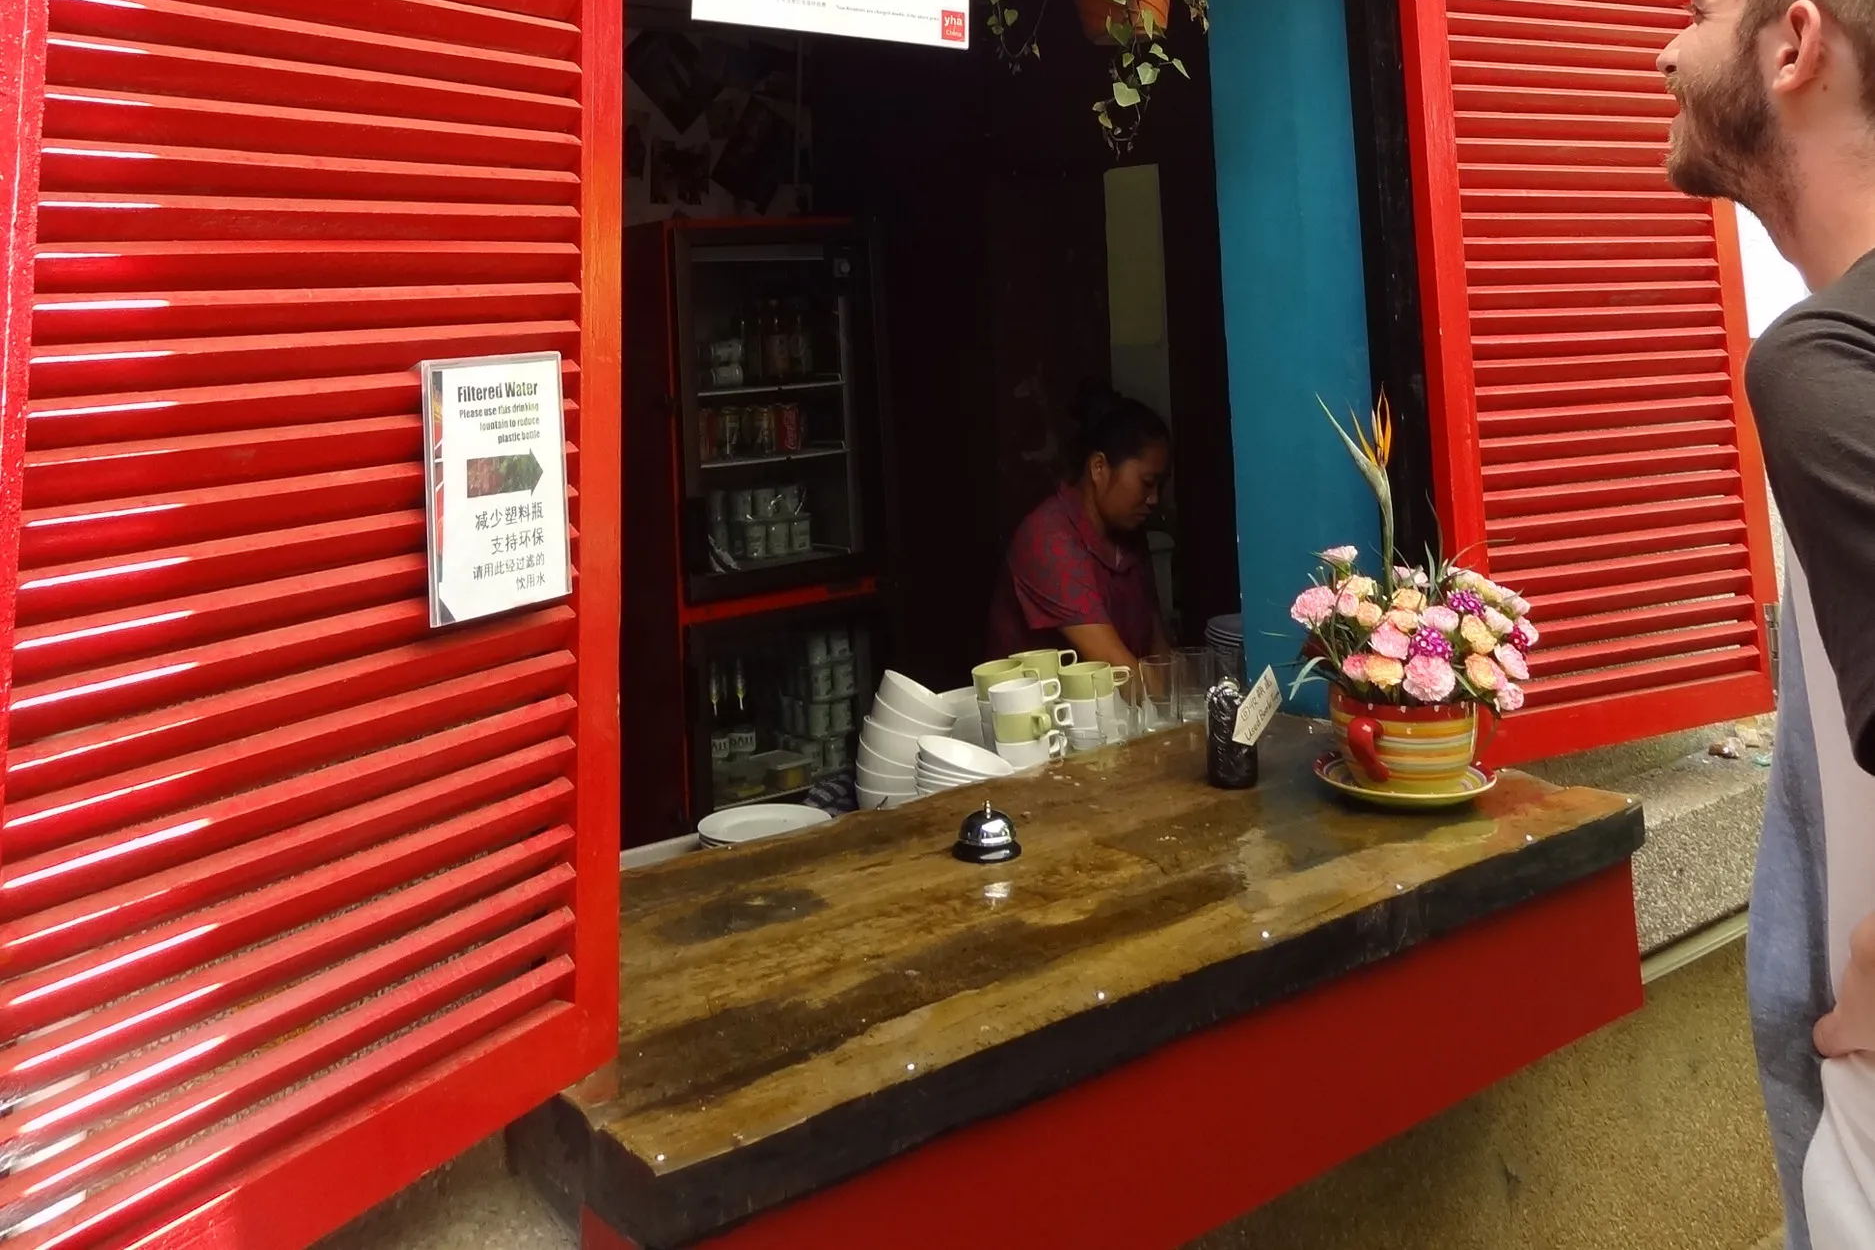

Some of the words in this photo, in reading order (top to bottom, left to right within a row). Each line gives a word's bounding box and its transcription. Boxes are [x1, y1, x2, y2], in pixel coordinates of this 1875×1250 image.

[944, 15, 962, 27] yha
[457, 383, 503, 403] Filtered
[505, 381, 538, 397] Water
[459, 408, 483, 419] Please
[484, 407, 497, 416] use
[498, 404, 511, 415] this
[512, 402, 539, 414] drinking
[479, 419, 508, 431] fountain
[509, 418, 516, 428] to
[517, 416, 540, 427] reduce
[498, 432, 521, 444] plastic
[522, 430, 540, 440] bottle
[475, 502, 544, 531] 减少塑料瓶
[491, 527, 544, 555] 支持环保
[473, 552, 545, 580] 请用此经过滤的
[516, 571, 546, 590] 饮用水
